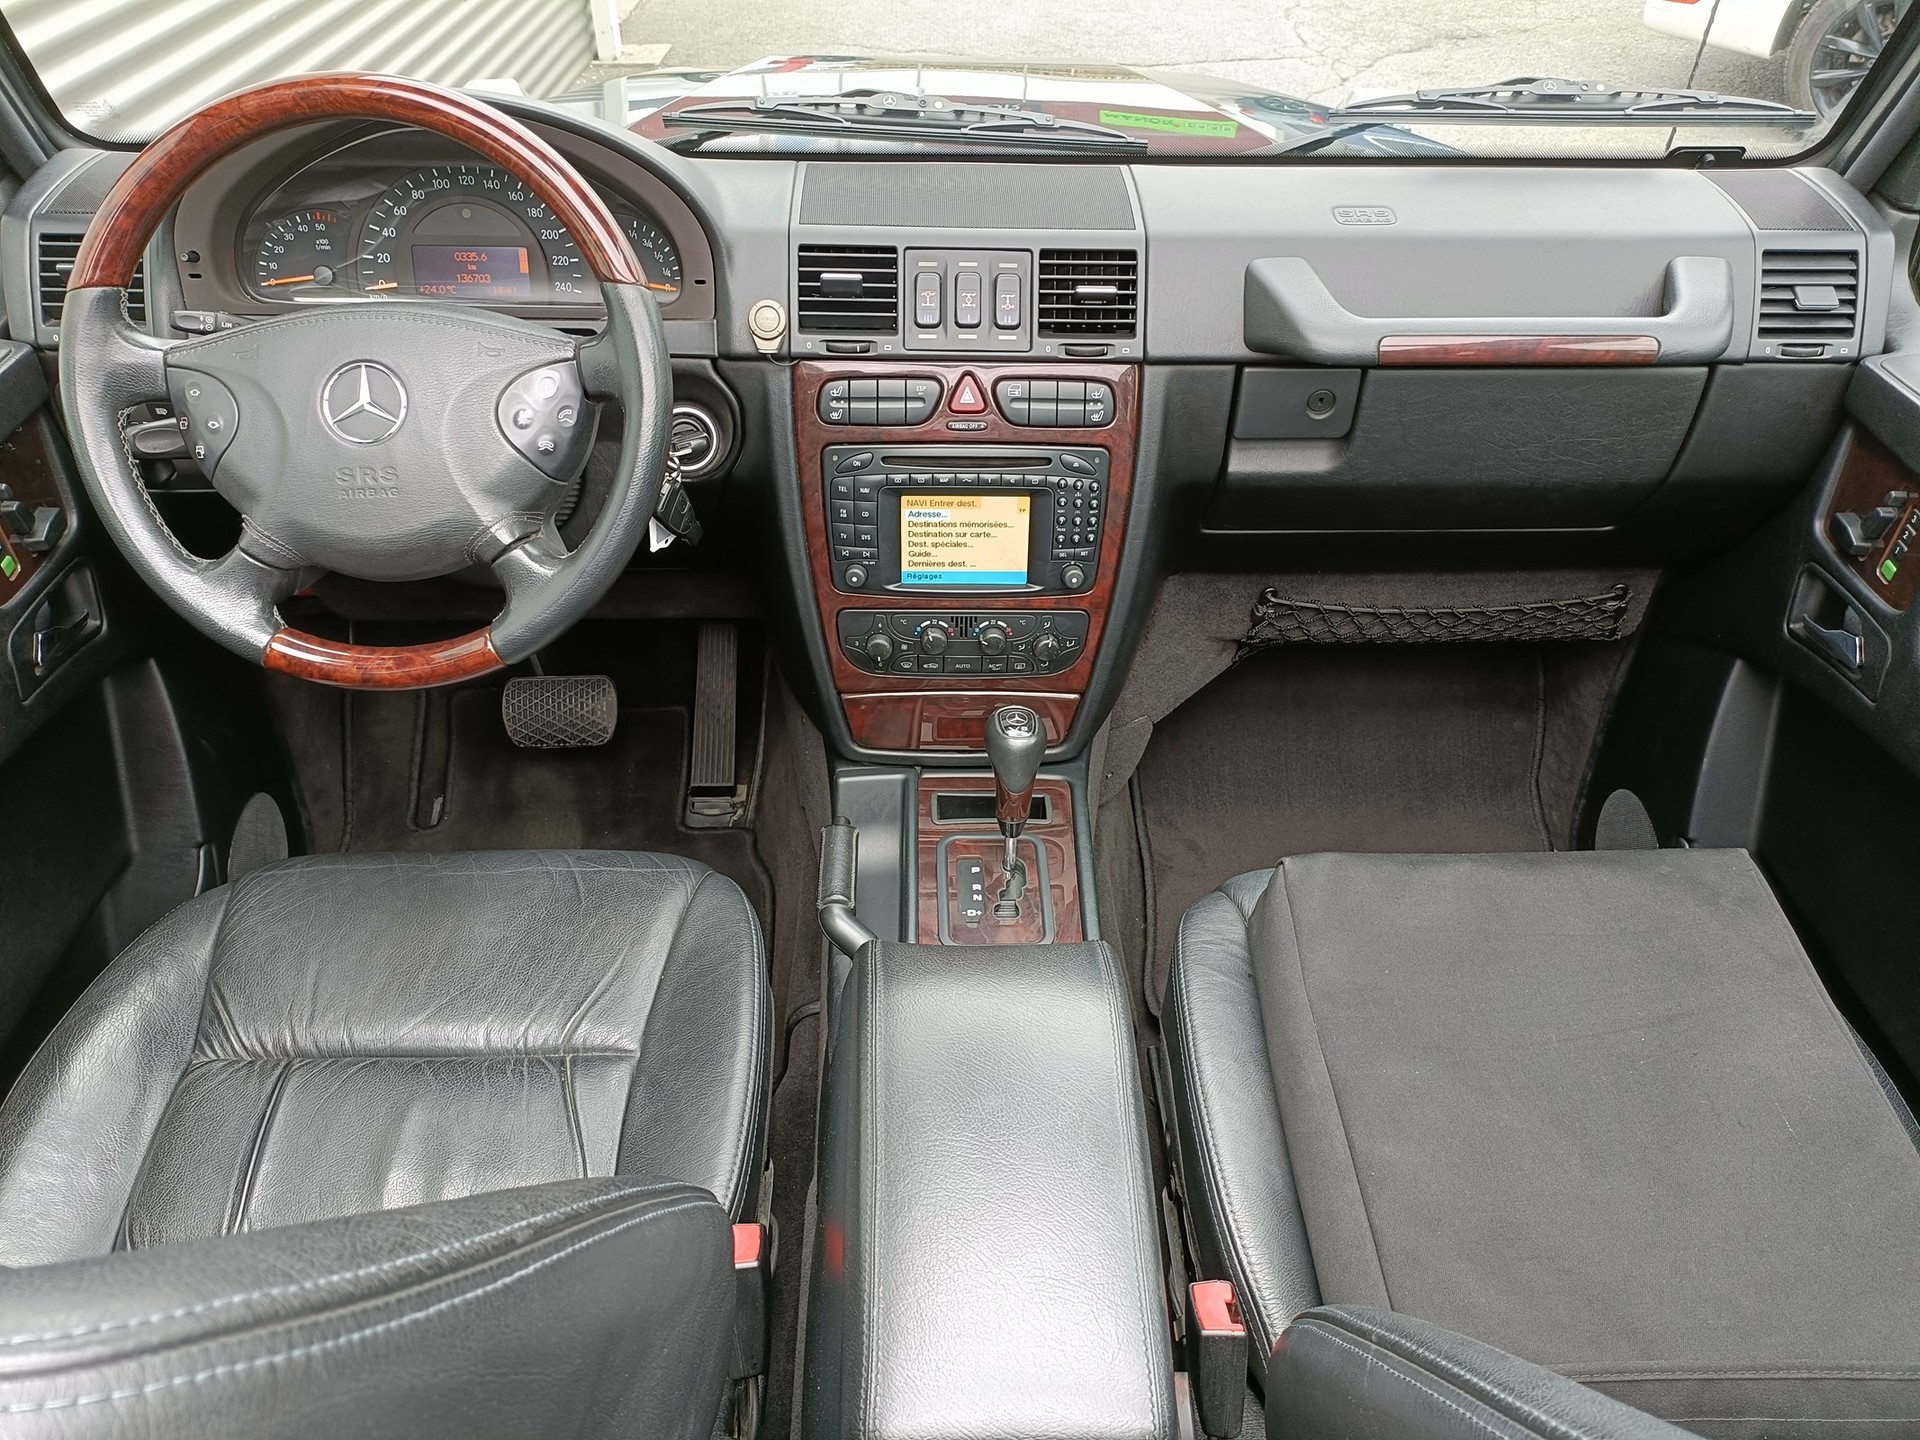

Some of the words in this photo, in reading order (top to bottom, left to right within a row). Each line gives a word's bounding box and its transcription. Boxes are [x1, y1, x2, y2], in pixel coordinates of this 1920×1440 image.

[432, 179, 450, 189] 100
[458, 176, 475, 186] 120
[483, 179, 500, 190] 140
[411, 190, 425, 200] 80
[508, 191, 524, 201] 160
[393, 206, 407, 216] 60
[527, 208, 543, 218] 180
[297, 224, 308, 232] 40
[315, 223, 326, 231] 50
[284, 233, 294, 241] 30
[382, 228, 396, 238] 40
[541, 229, 559, 240] 200
[642, 238, 653, 249] 3/4
[273, 245, 284, 254] 20
[377, 253, 390, 263] 20
[454, 252, 488, 262] 0335.6
[552, 256, 569, 266] 220
[654, 251, 664, 263] 1/2
[269, 262, 277, 270] 10
[662, 268, 671, 277] 1/4
[456, 274, 491, 283] 136703
[555, 282, 572, 292] 240
[336, 466, 399, 485] SRS
[339, 487, 399, 499] AIRBAG
[908, 510, 948, 518] Adresse...
[1911, 515, 1917, 524] 3
[1902, 531, 1909, 540] 2
[908, 540, 929, 548] Dest.
[931, 540, 974, 549] spéciales...
[908, 550, 938, 558] Guide...
[948, 560, 968, 568] dest.
